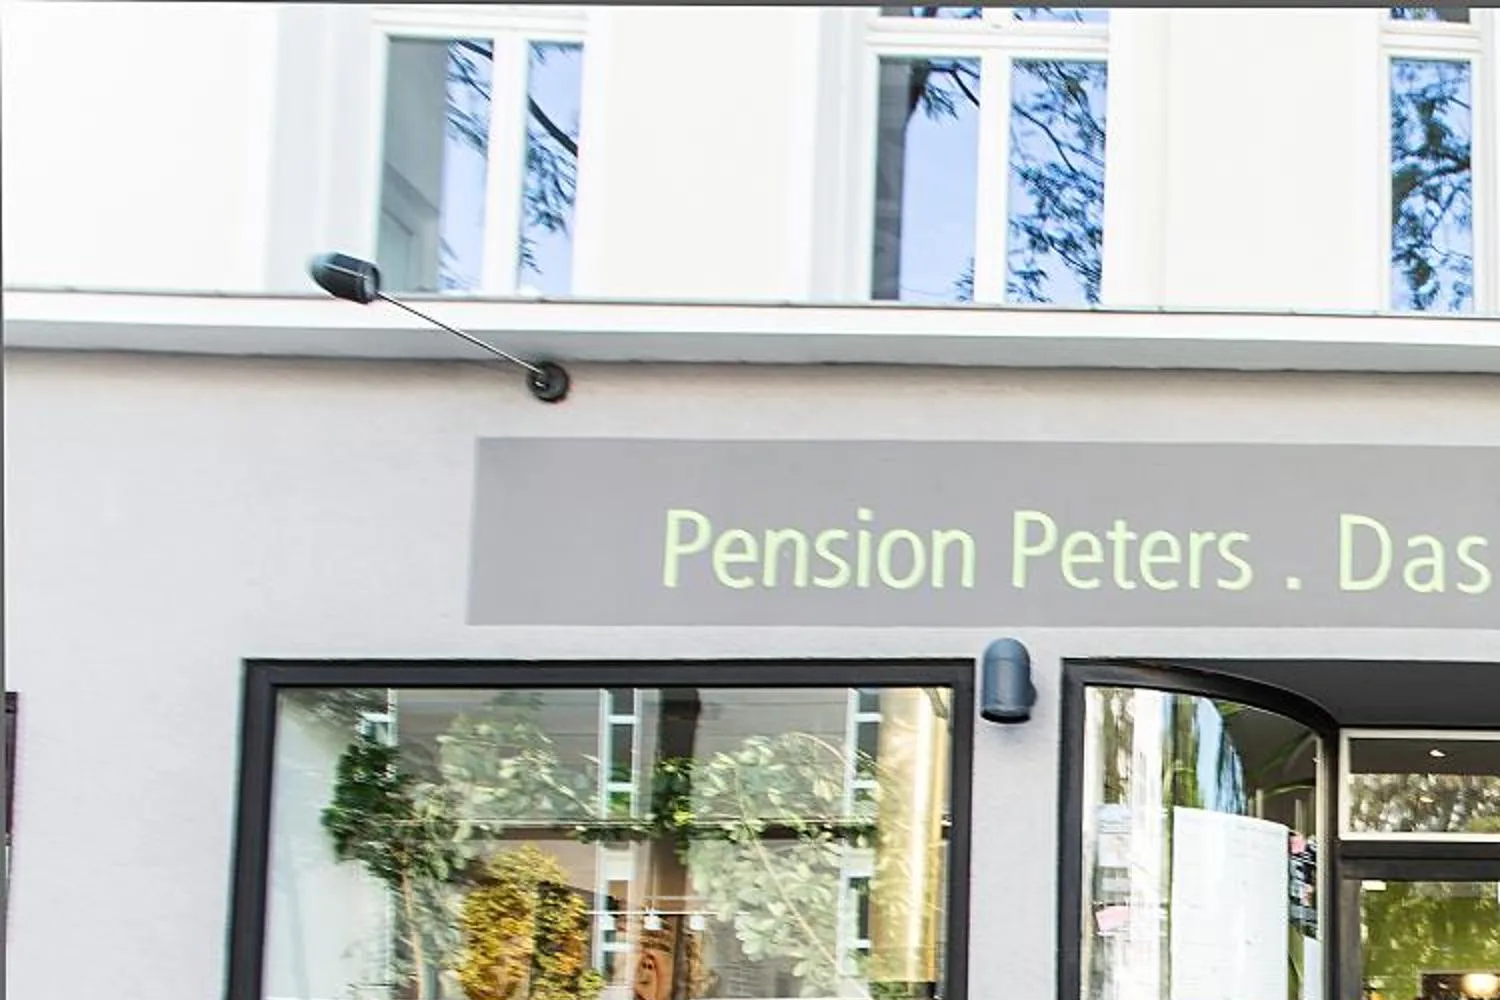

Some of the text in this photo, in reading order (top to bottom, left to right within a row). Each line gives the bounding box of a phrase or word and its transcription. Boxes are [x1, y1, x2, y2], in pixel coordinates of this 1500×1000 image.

[662, 507, 977, 590] Pension
[1011, 509, 1255, 592] Peters
[1338, 513, 1493, 596] Das
